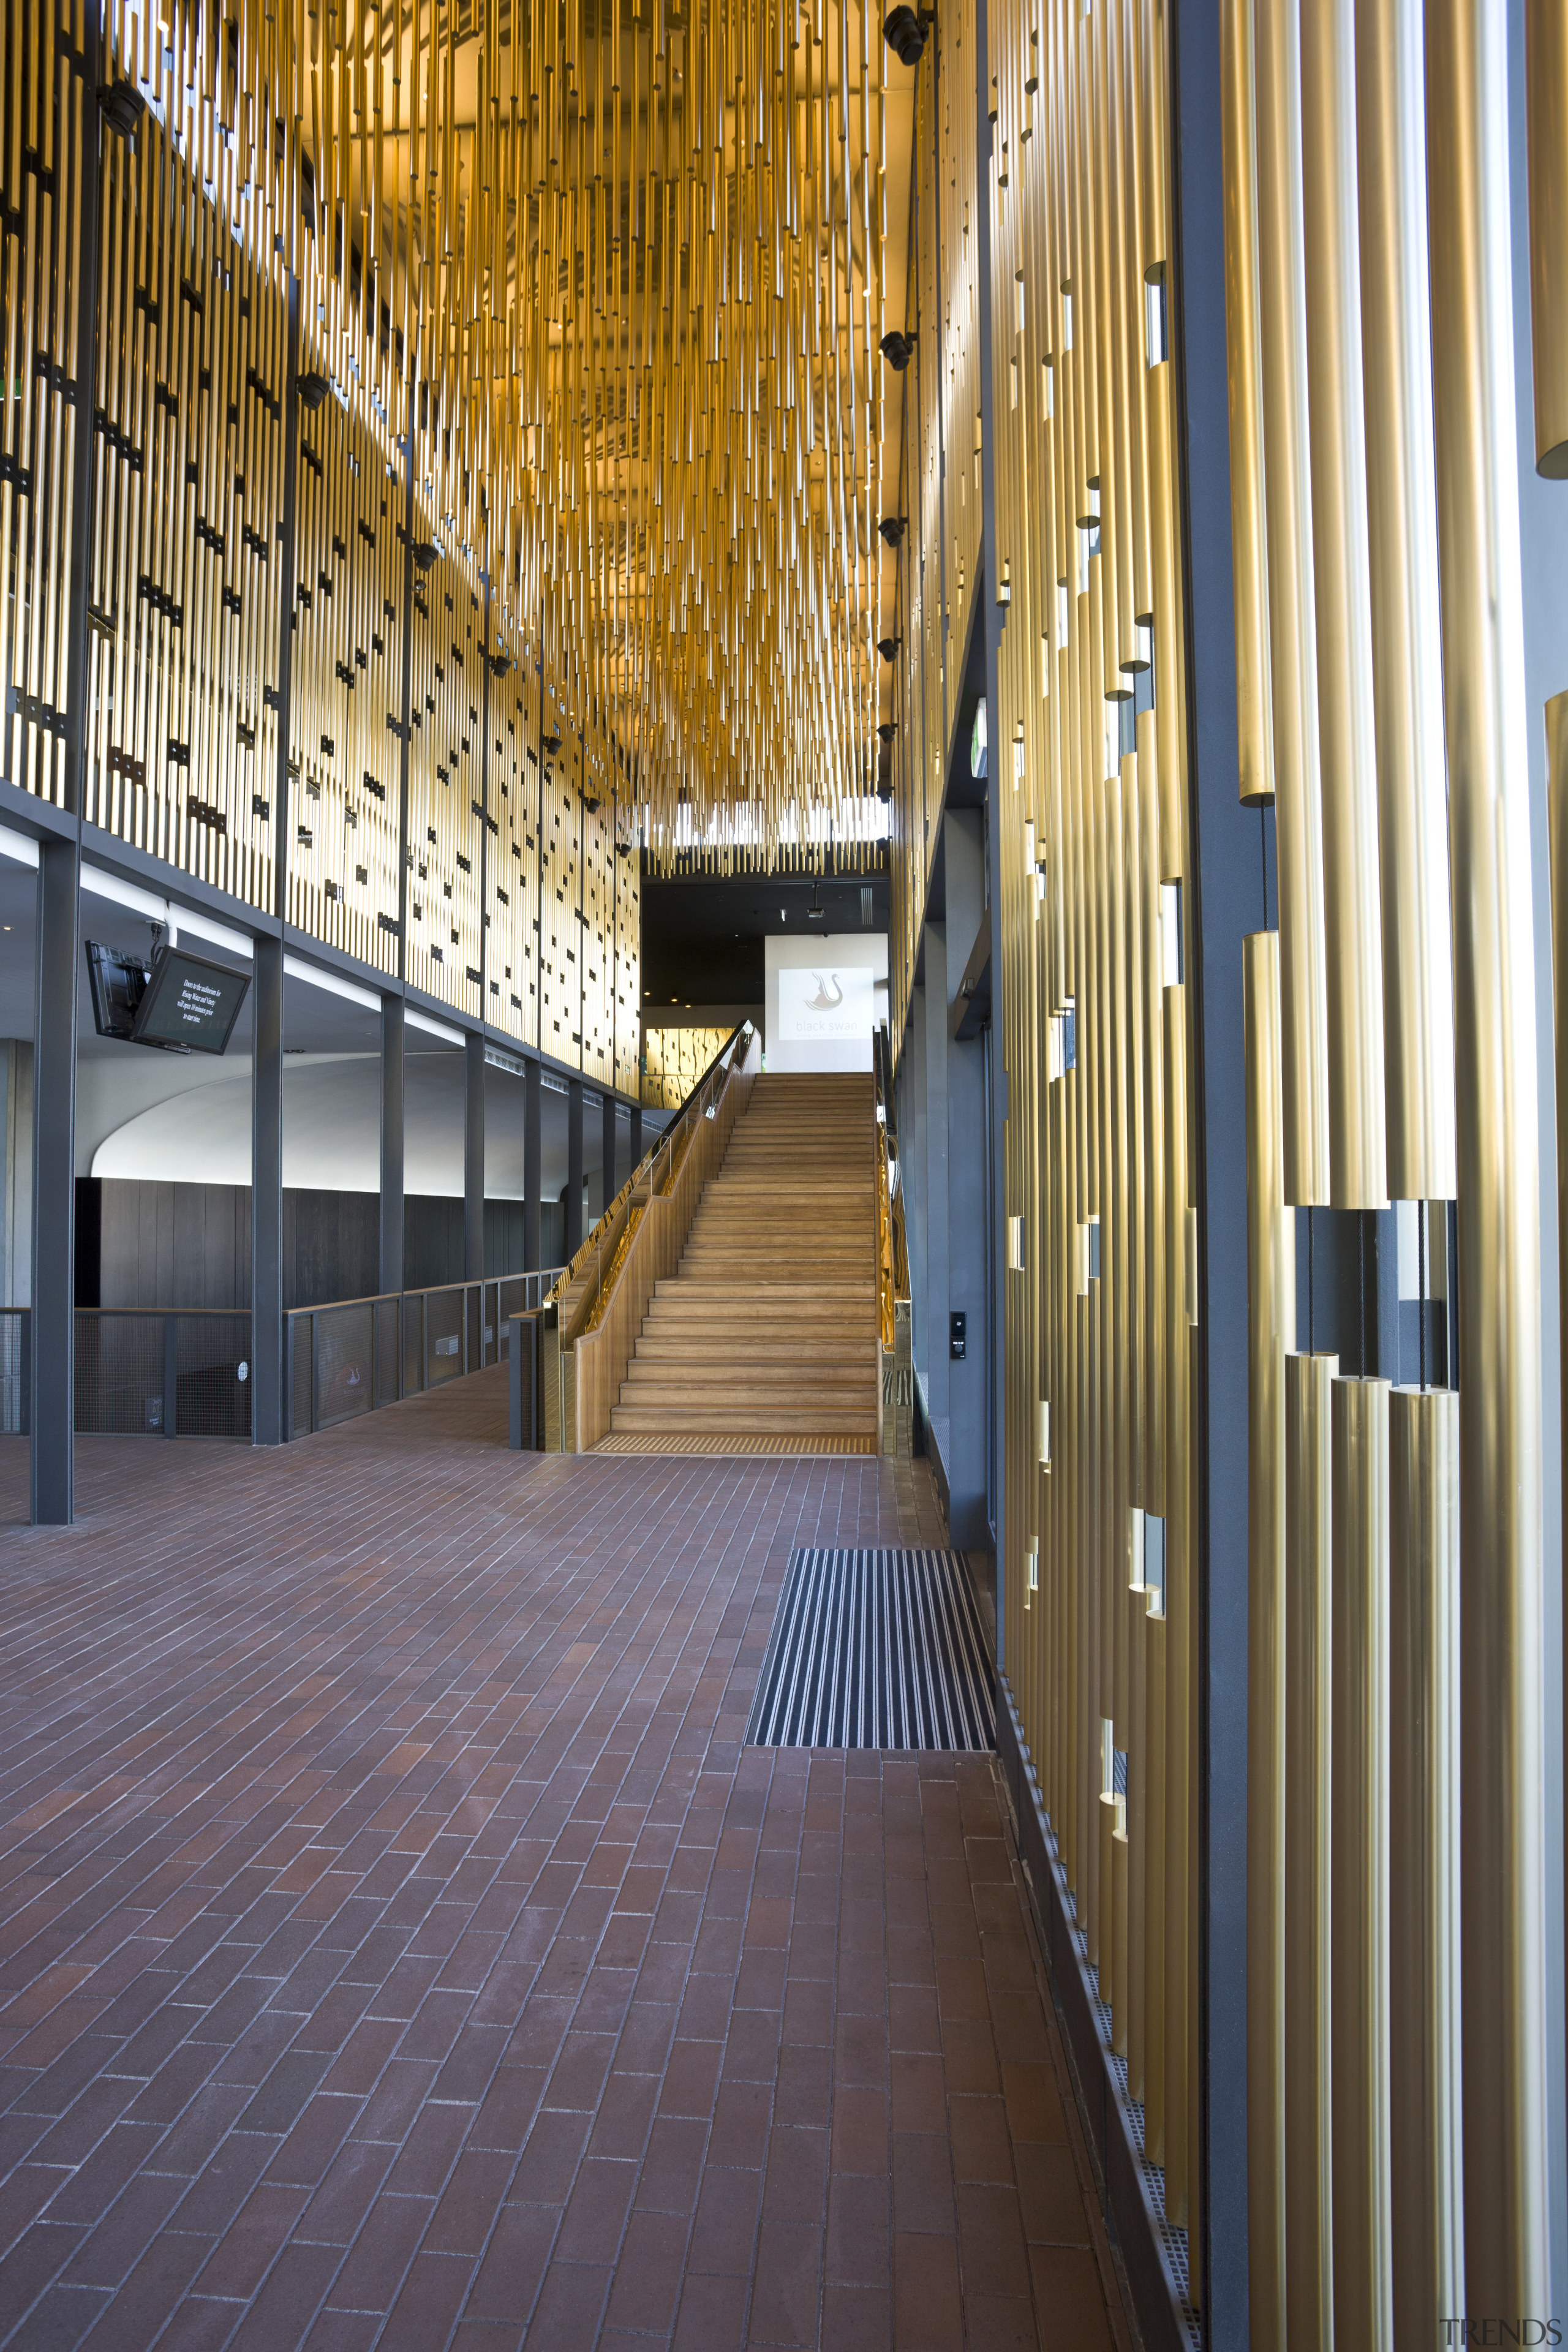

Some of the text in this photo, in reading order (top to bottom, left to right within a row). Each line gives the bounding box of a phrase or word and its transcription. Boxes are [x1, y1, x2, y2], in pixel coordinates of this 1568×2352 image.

[184, 979, 193, 988] Doors
[201, 986, 216, 995] auditorium
[182, 990, 192, 1000] Rising
[192, 992, 201, 1001] Water
[206, 997, 216, 1007] Ninety
[194, 1005, 206, 1014] minutes
[796, 1020, 858, 1031] black swan
